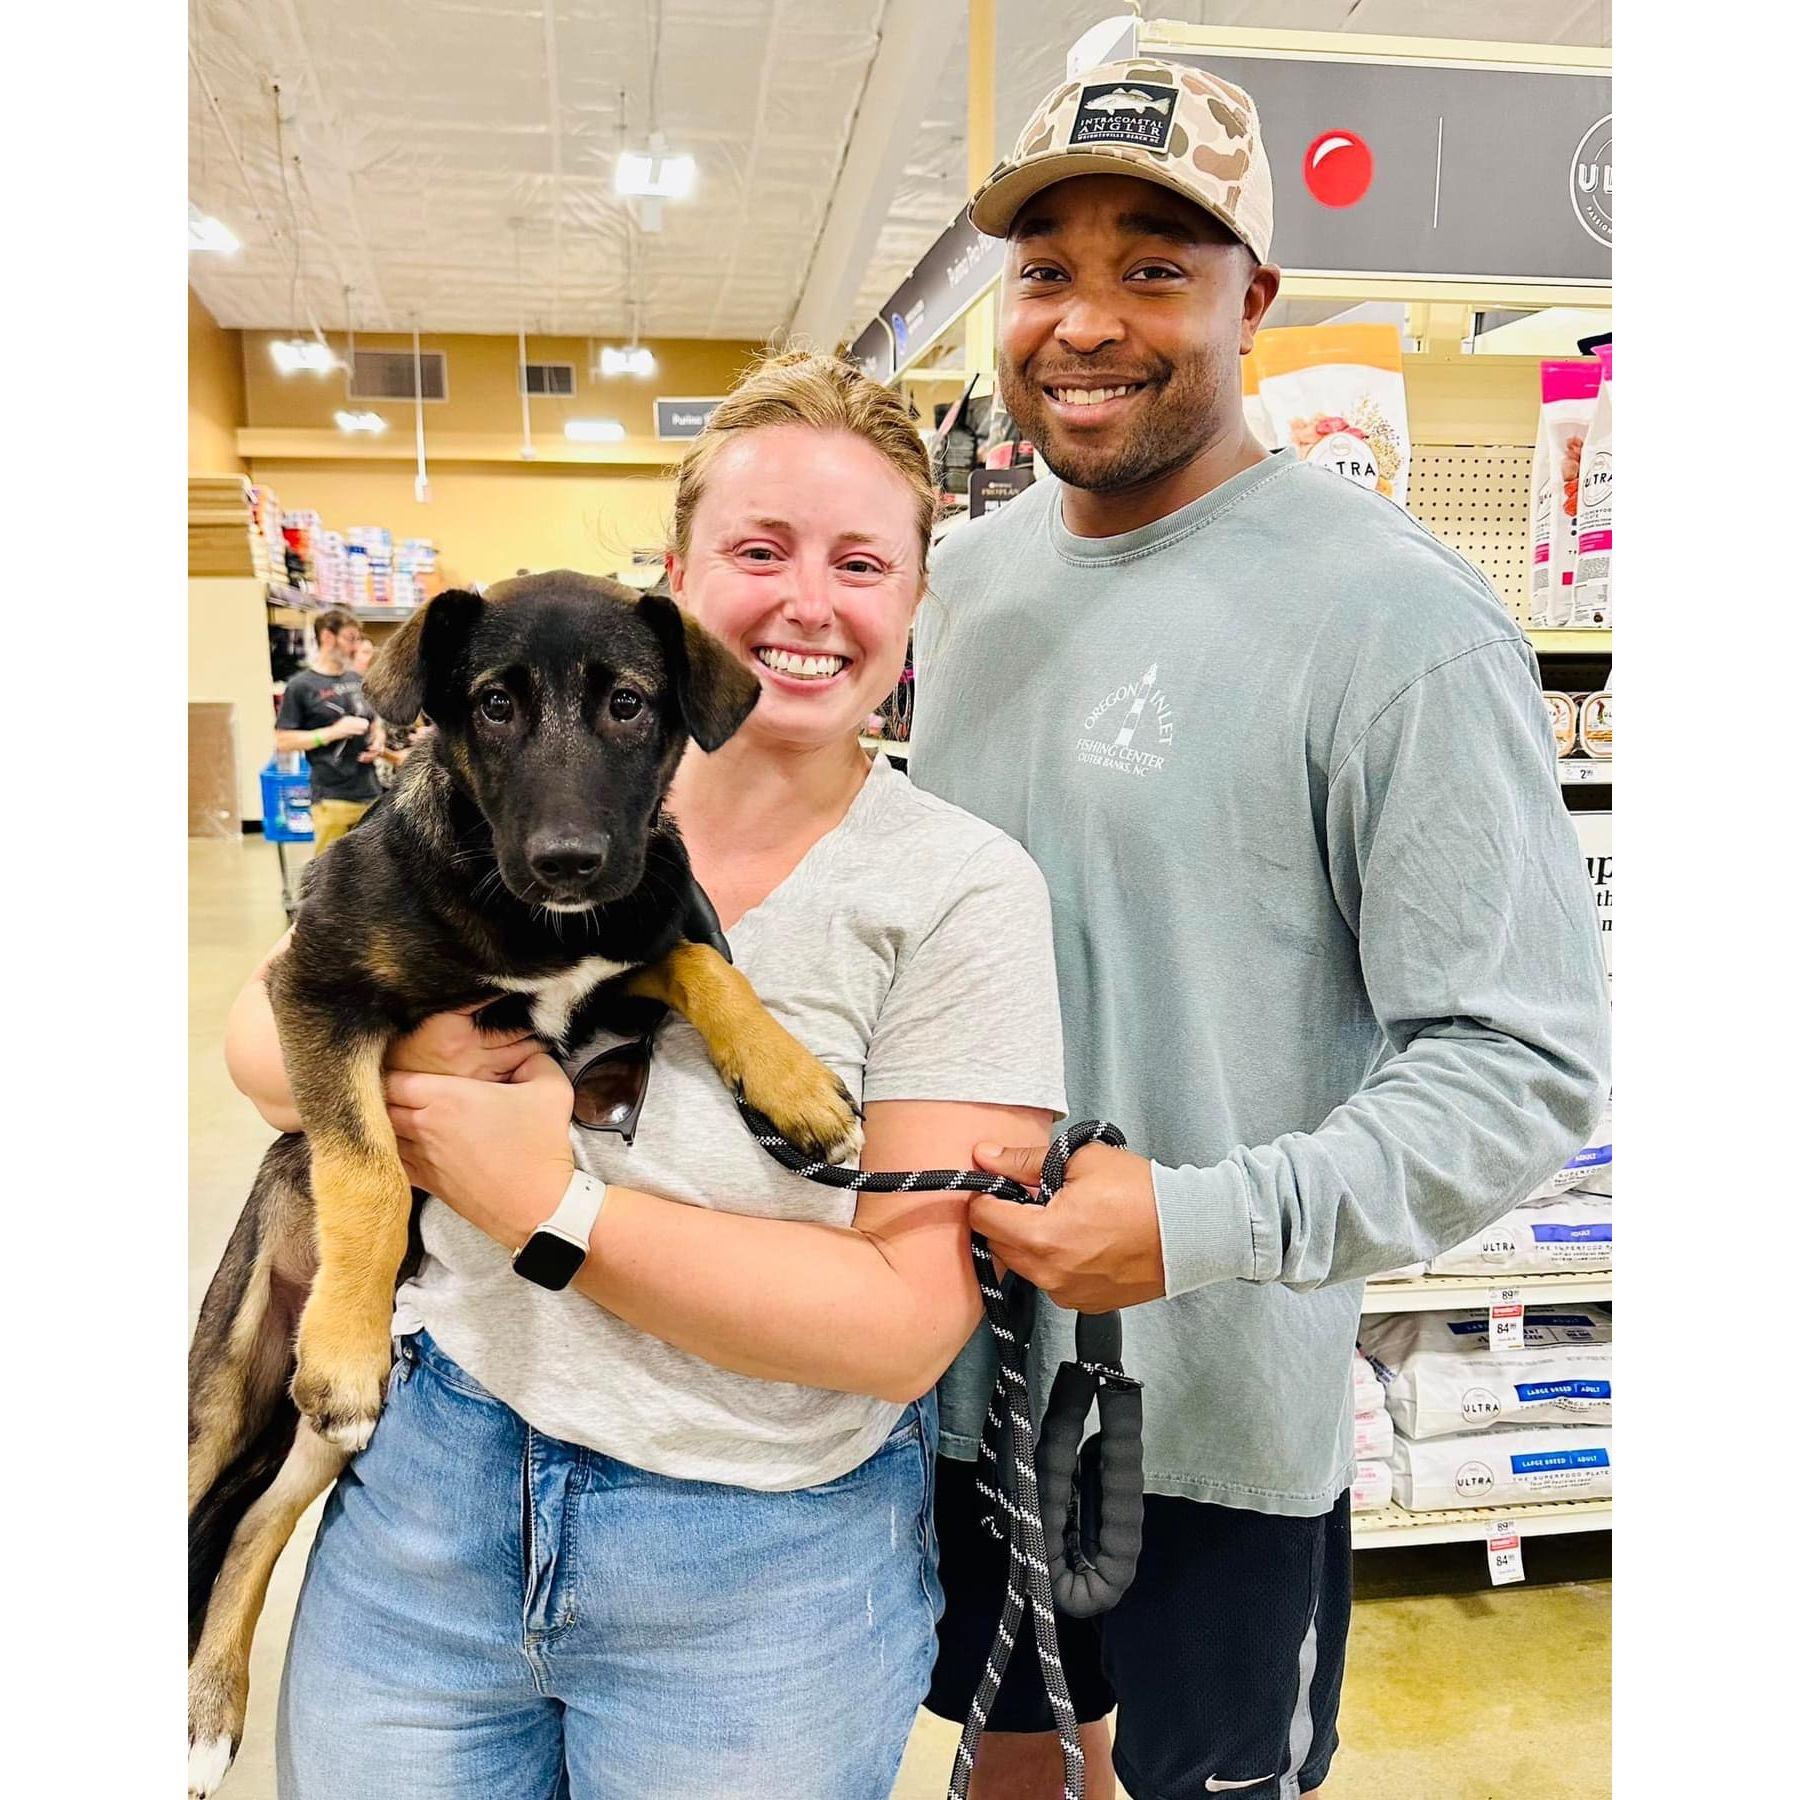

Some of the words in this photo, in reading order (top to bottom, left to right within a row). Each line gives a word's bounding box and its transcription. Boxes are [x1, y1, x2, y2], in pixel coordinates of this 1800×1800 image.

[1081, 116, 1163, 128] INTRACOASTAL
[1080, 122, 1160, 136] ANGLER
[1084, 681, 1140, 730] OREGON
[1150, 689, 1173, 746] INLET
[1076, 738, 1119, 757] FISHING
[1118, 747, 1165, 769] CENTER
[1078, 752, 1103, 768] OUTER
[1132, 765, 1149, 777] NC
[1482, 1241, 1516, 1252] ULTRA
[1526, 1387, 1549, 1396] LARGE
[1581, 1385, 1600, 1393] ADULT
[1463, 1403, 1499, 1414] ULTRA
[1522, 1459, 1543, 1468] LARGE
[1544, 1457, 1566, 1466] BREED
[1577, 1455, 1597, 1463] ADULT
[1457, 1476, 1492, 1487] ULTRA
